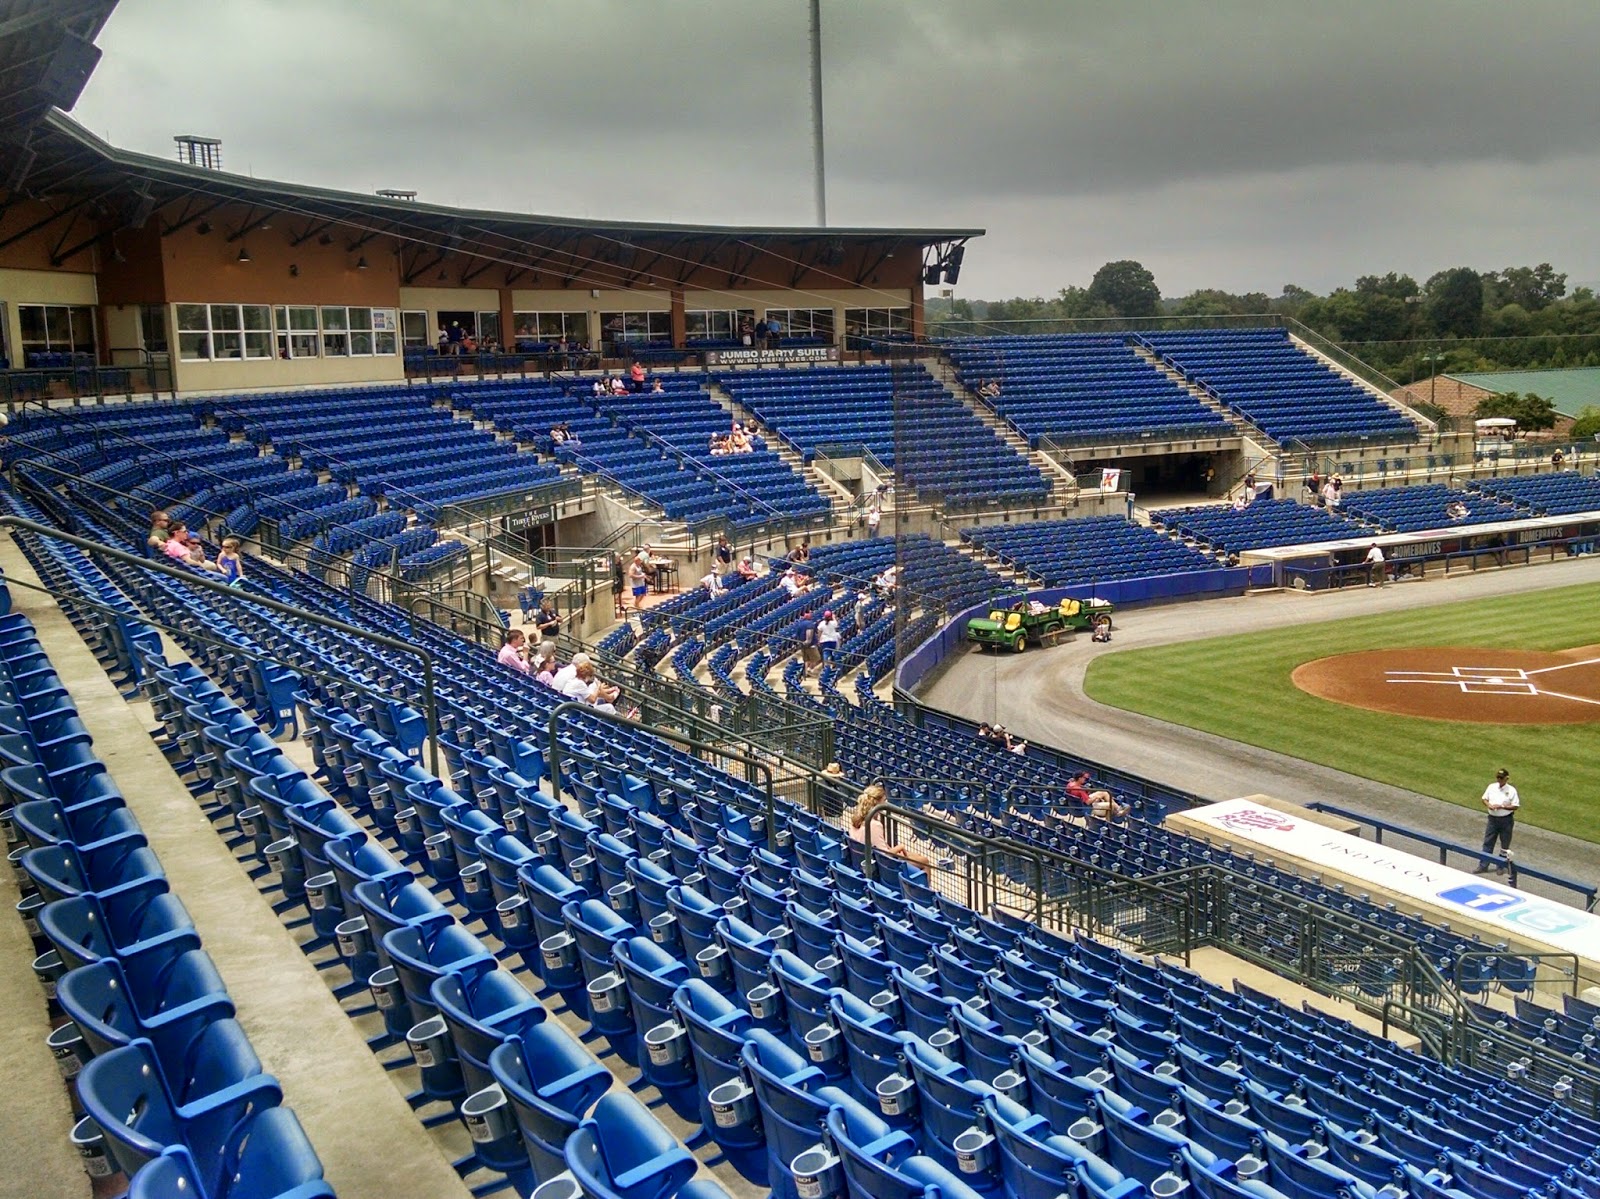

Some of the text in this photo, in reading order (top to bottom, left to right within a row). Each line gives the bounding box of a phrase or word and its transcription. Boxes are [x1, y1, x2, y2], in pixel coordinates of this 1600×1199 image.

[720, 348, 828, 359] JUMBO PARTY SUITE
[1103, 473, 1117, 488] K
[1320, 841, 1370, 860] FIND
[1403, 869, 1440, 883] ON
[1342, 964, 1361, 973] 107
